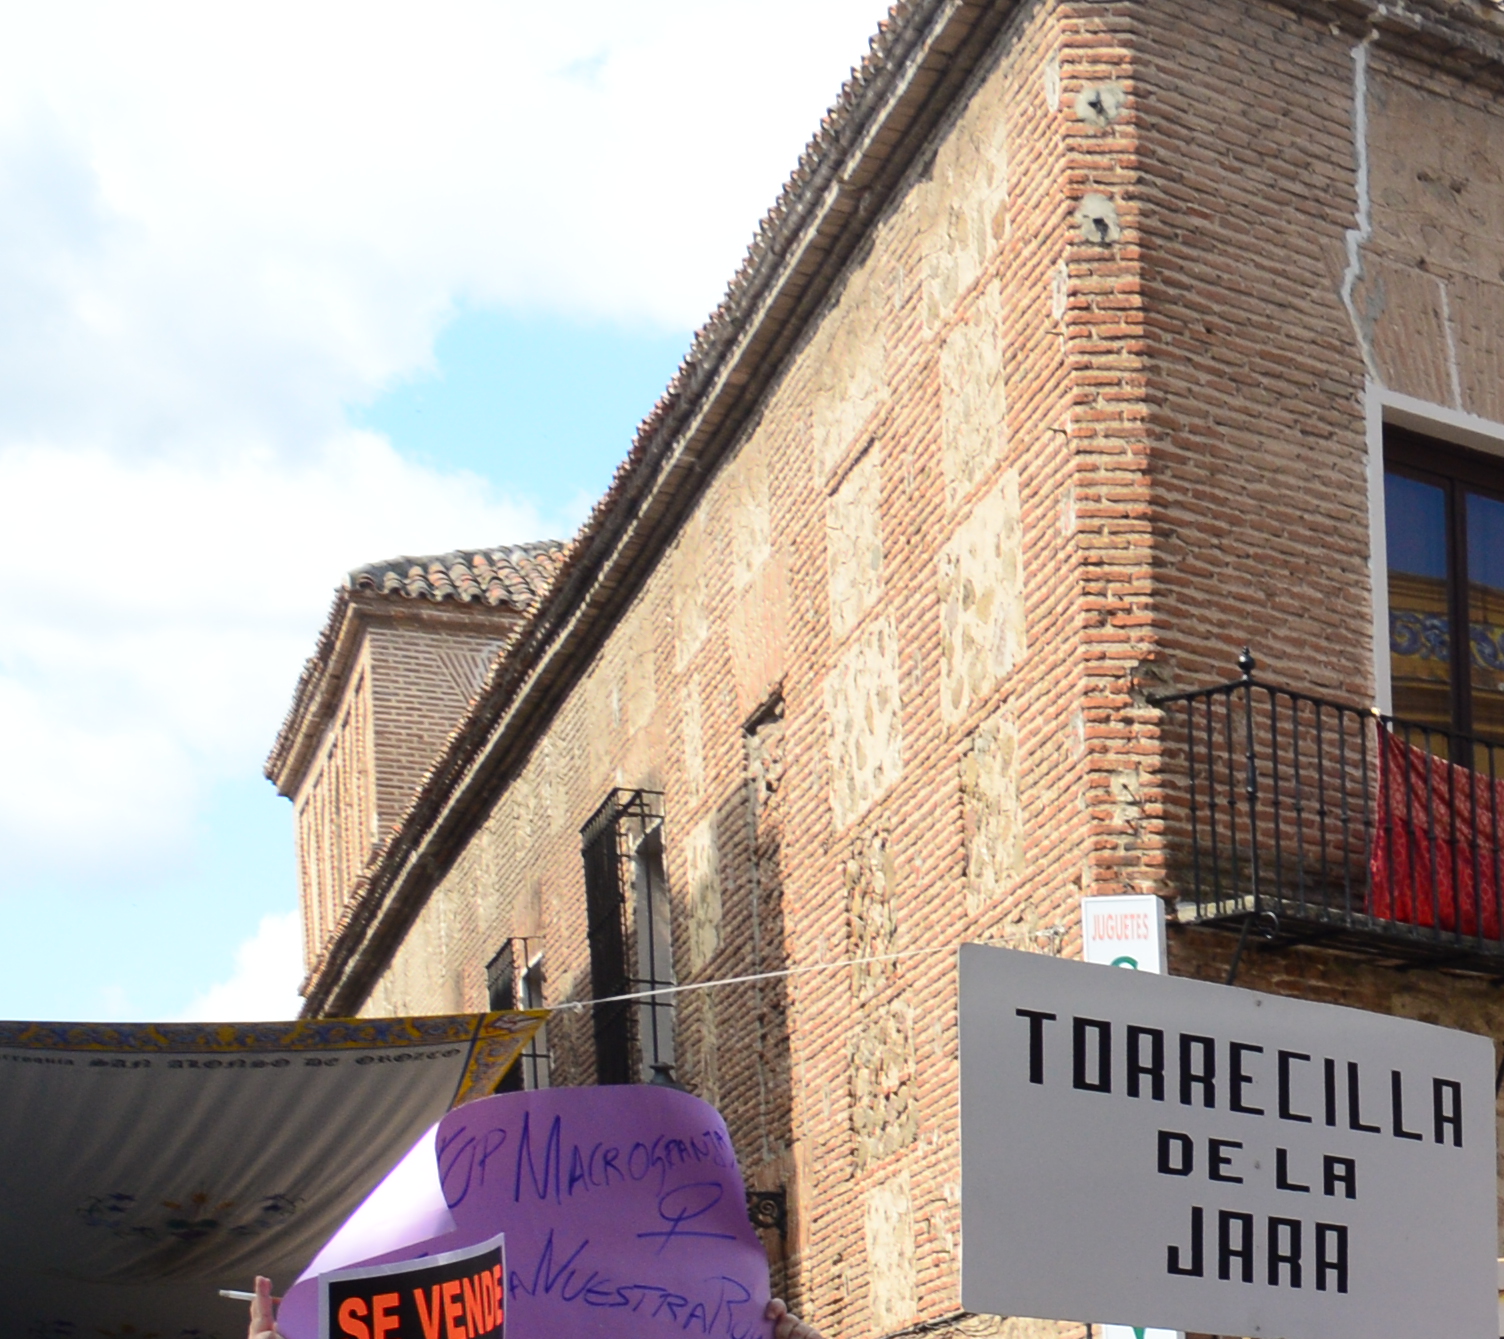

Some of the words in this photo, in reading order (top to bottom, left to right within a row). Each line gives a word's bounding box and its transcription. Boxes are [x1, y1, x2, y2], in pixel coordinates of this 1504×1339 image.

[1092, 913, 1149, 941] JUGUETES
[1016, 1008, 1463, 1148] TORRECILLA
[1158, 1130, 1243, 1184] DE
[1276, 1148, 1356, 1200] LA
[1167, 1206, 1348, 1294] JARA
